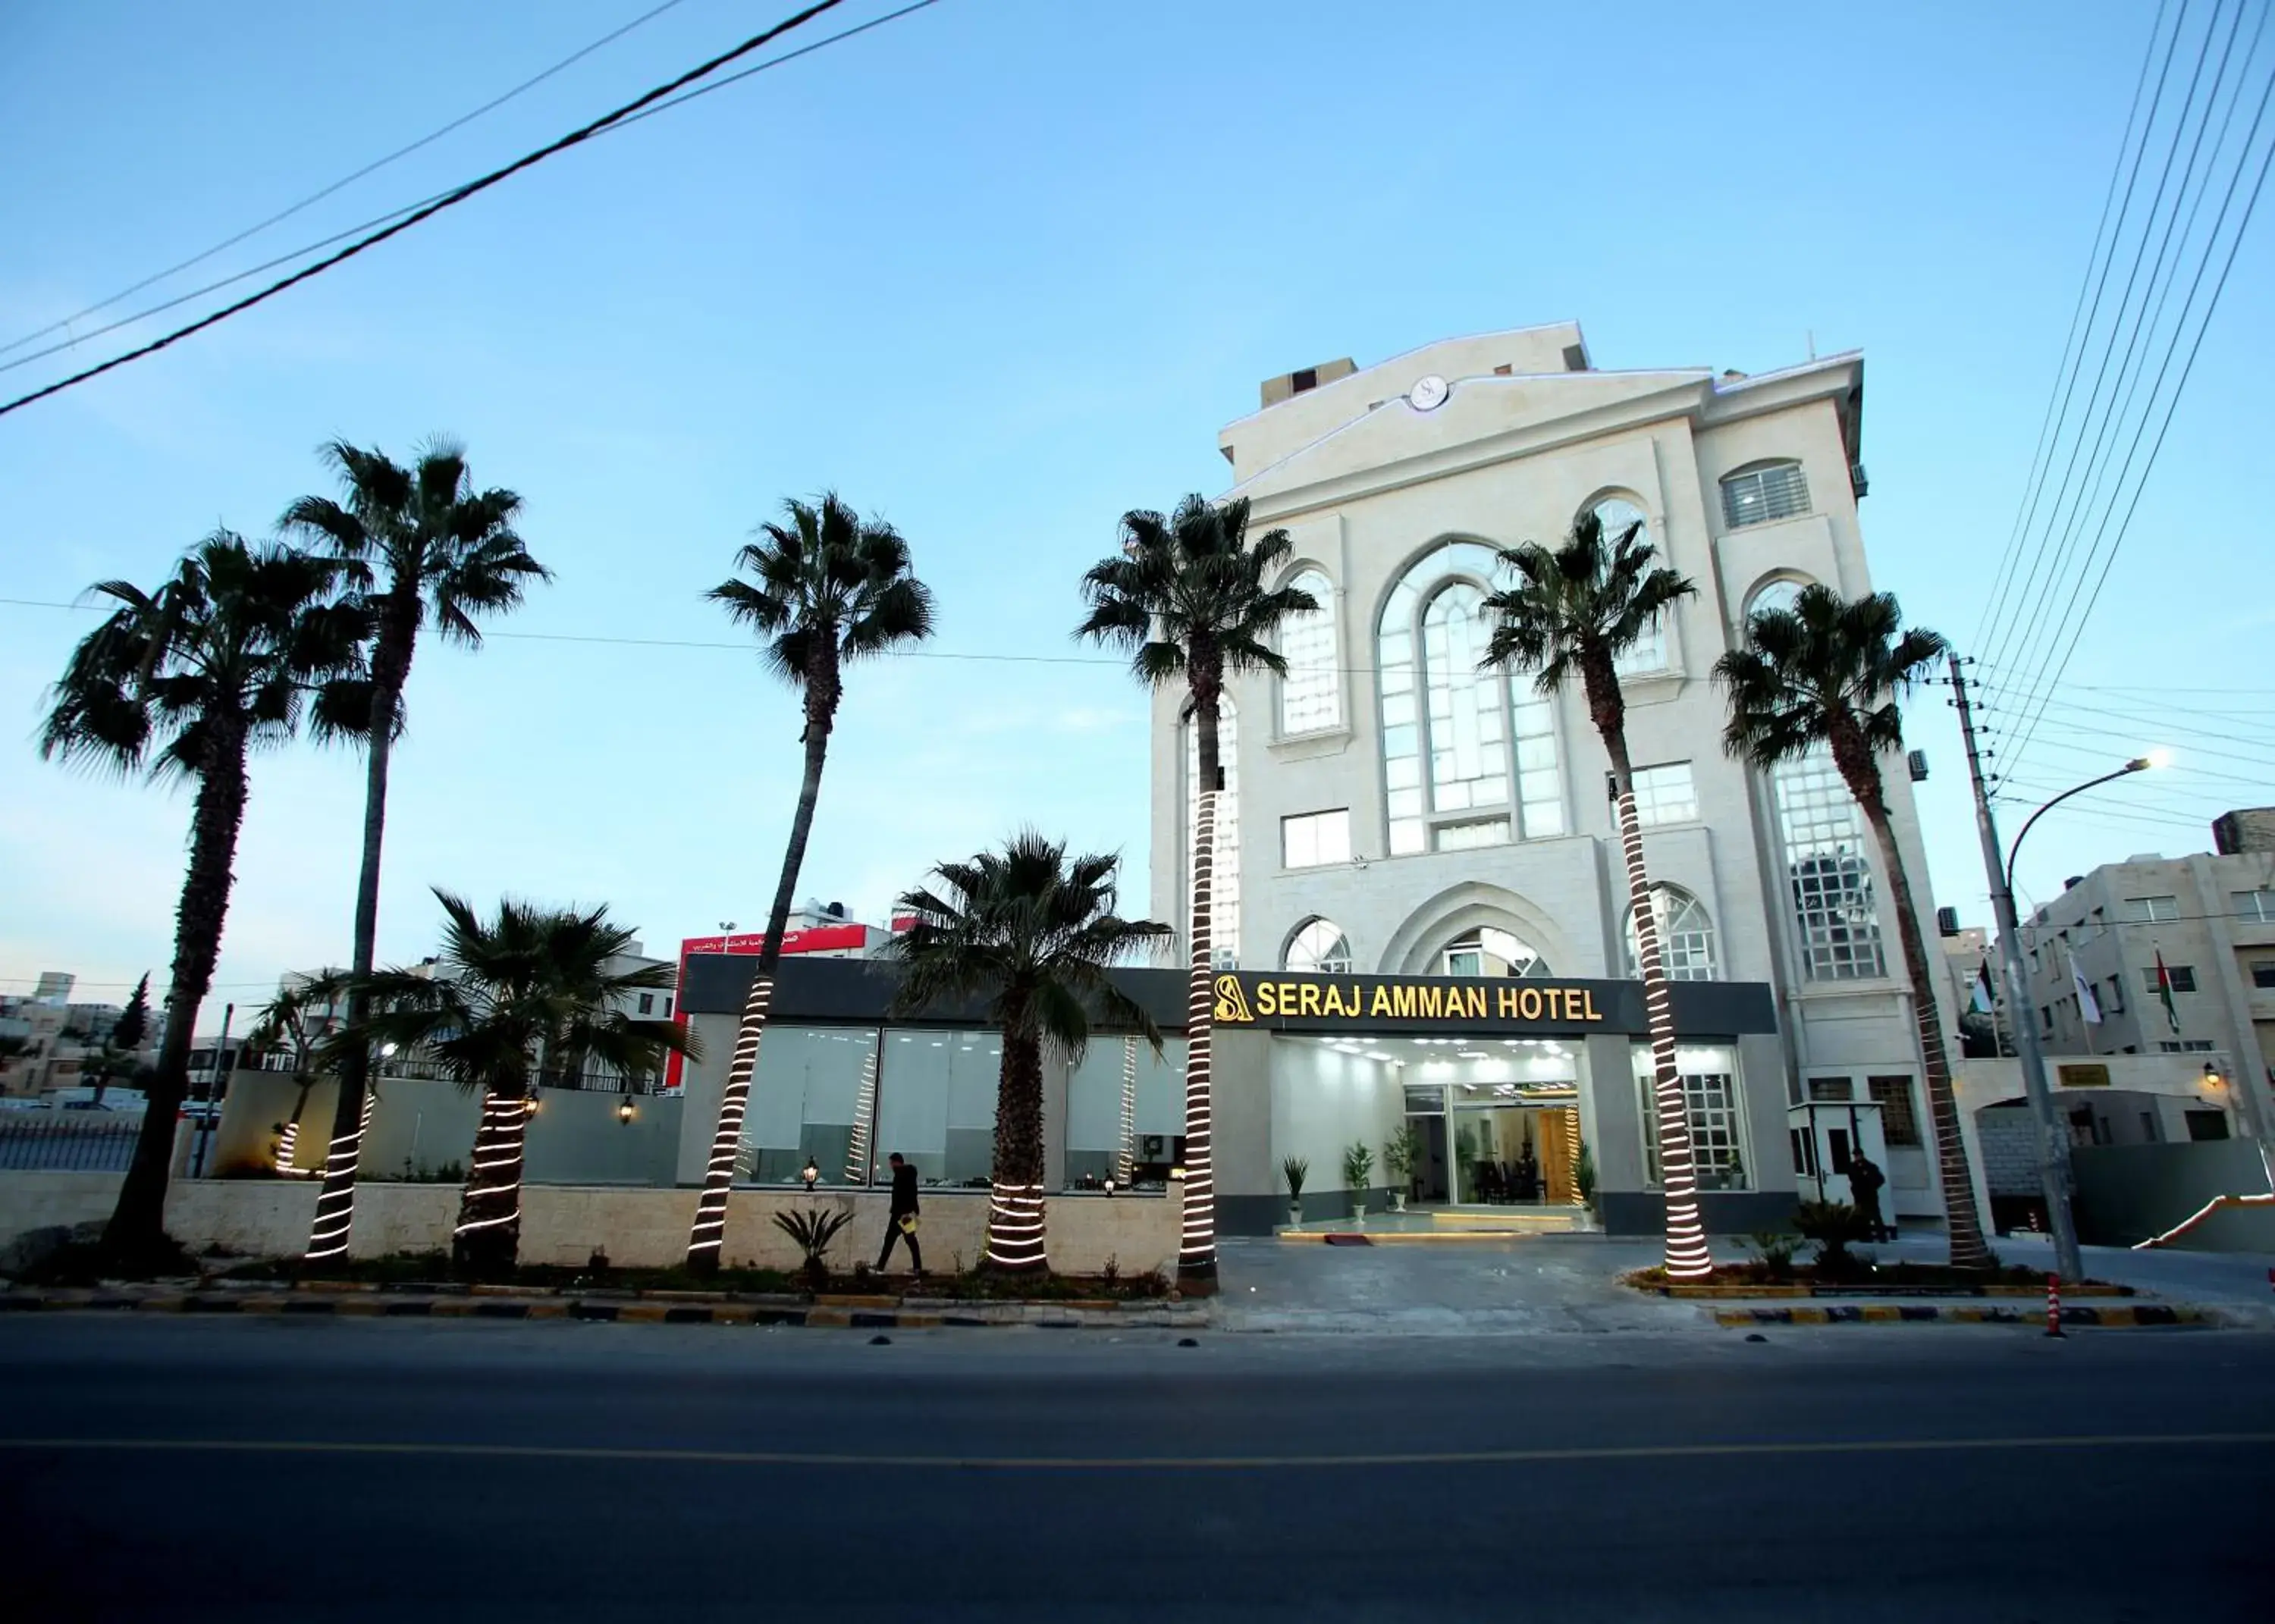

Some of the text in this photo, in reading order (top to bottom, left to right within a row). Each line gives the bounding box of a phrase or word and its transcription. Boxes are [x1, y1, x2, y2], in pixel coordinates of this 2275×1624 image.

[1257, 982, 1602, 1020] SERAJ AMMAN HOTEL
